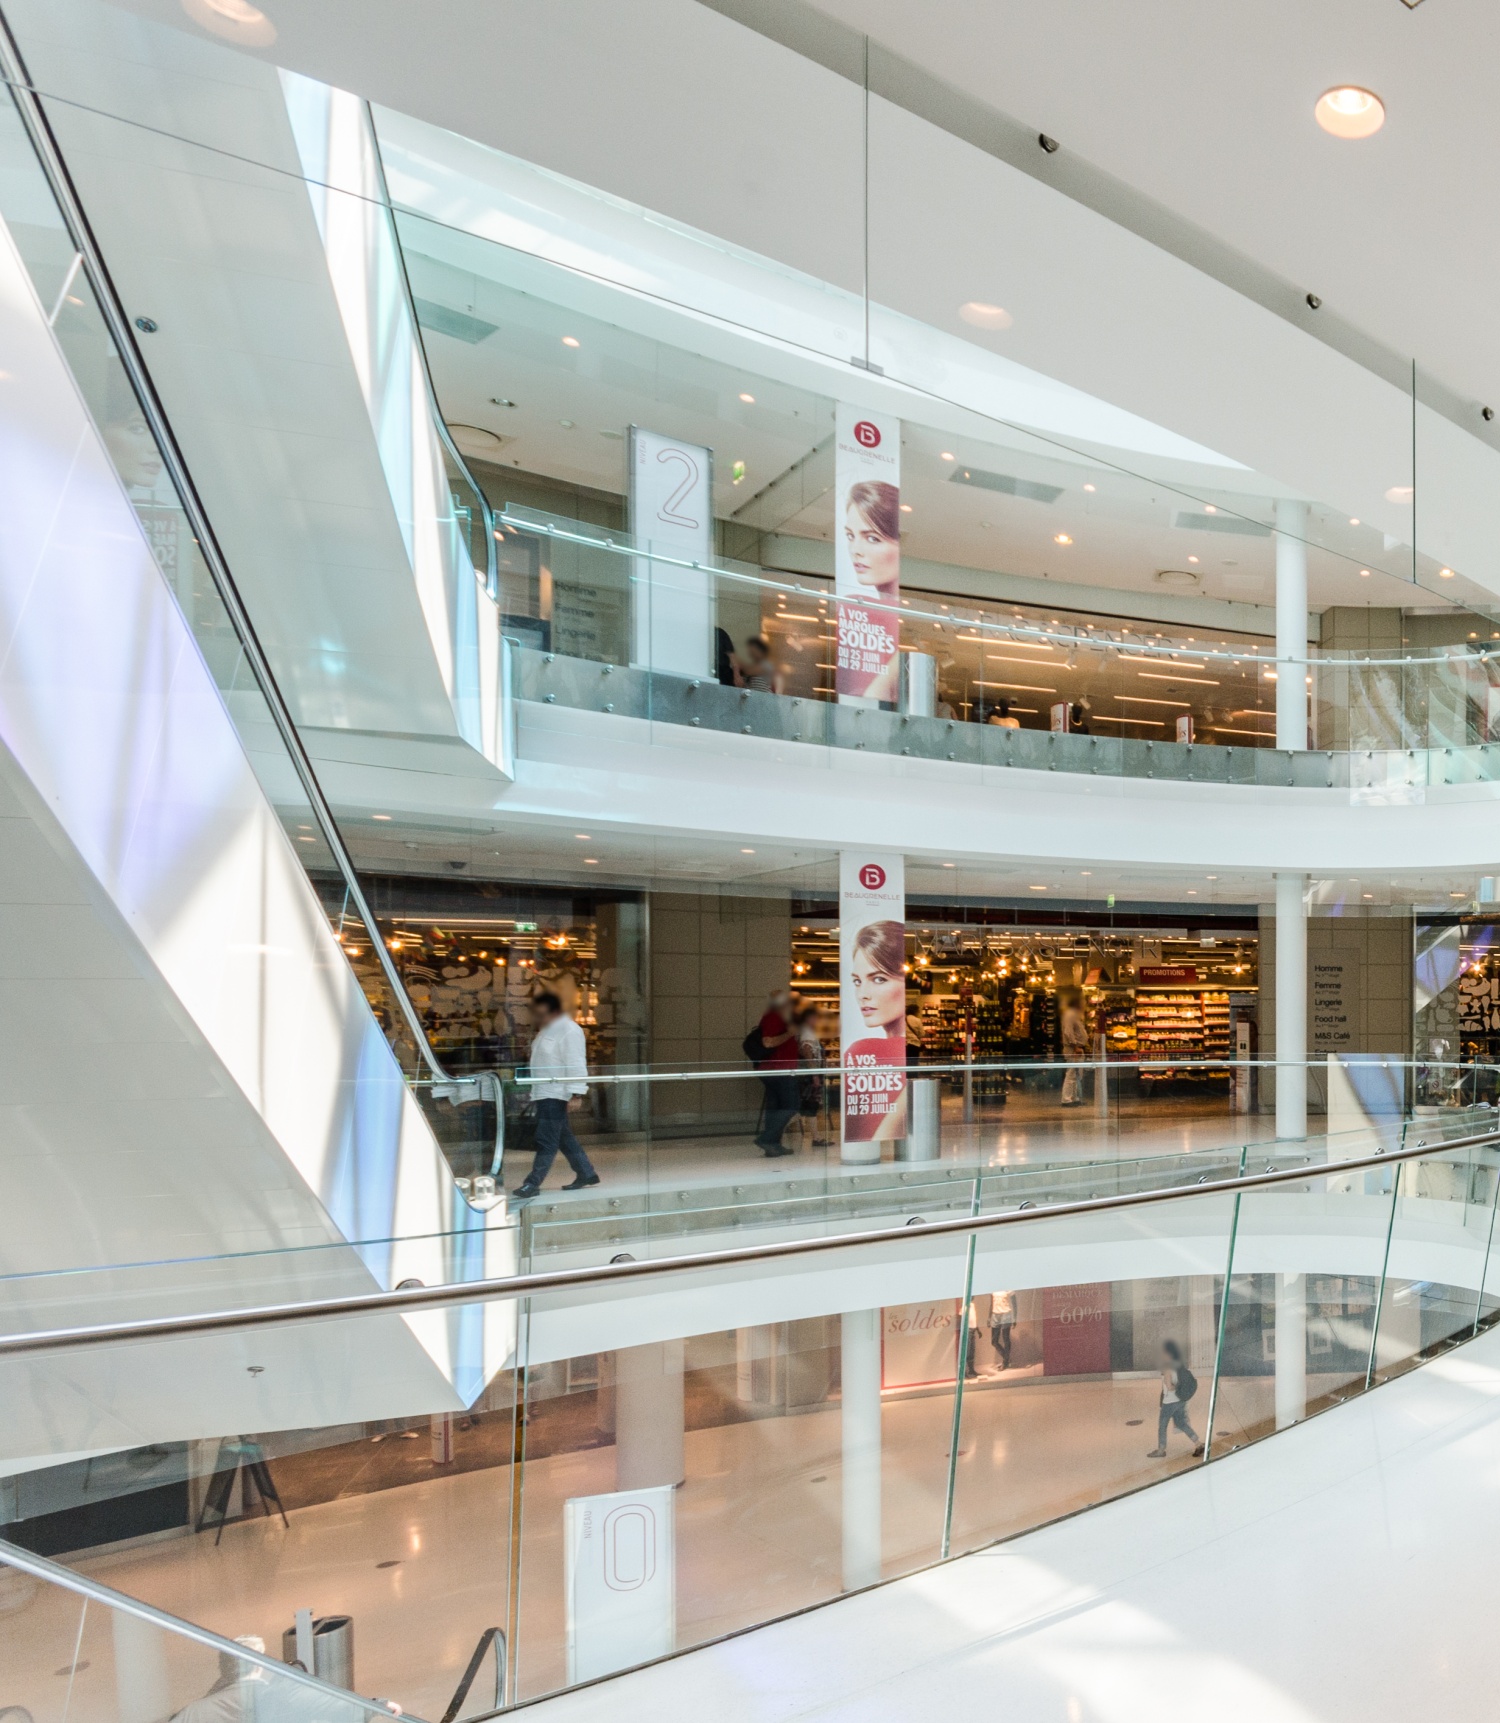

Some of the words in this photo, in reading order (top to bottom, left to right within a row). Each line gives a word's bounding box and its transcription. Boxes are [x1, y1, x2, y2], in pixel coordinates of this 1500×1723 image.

[656, 448, 699, 529] 2
[848, 608, 868, 623] VOS
[838, 627, 896, 655] SOLDES
[838, 645, 849, 658] DU
[850, 648, 861, 660] 25
[862, 651, 880, 664] JUIN
[838, 657, 849, 669] AU
[850, 660, 860, 671] 29
[861, 662, 890, 676] JUILLET
[844, 891, 901, 901] BEAUGRENELLE
[1143, 968, 1186, 976] PROMOTIONS
[1314, 981, 1342, 989] Femme
[1314, 998, 1343, 1007] Lingerie
[1314, 1032, 1332, 1040] M&S
[1333, 1031, 1350, 1040] Café
[847, 1052, 854, 1066] À
[855, 1054, 876, 1066] VOS
[847, 1074, 903, 1093] SOLDES
[847, 1094, 858, 1105] DU
[859, 1094, 870, 1105] 25
[871, 1093, 888, 1104] JUIN
[847, 1104, 858, 1116] AU
[859, 1104, 869, 1115] 29
[870, 1102, 897, 1114] JUILLET
[888, 1308, 953, 1334] soldes
[583, 1510, 593, 1540] NIVEAU
